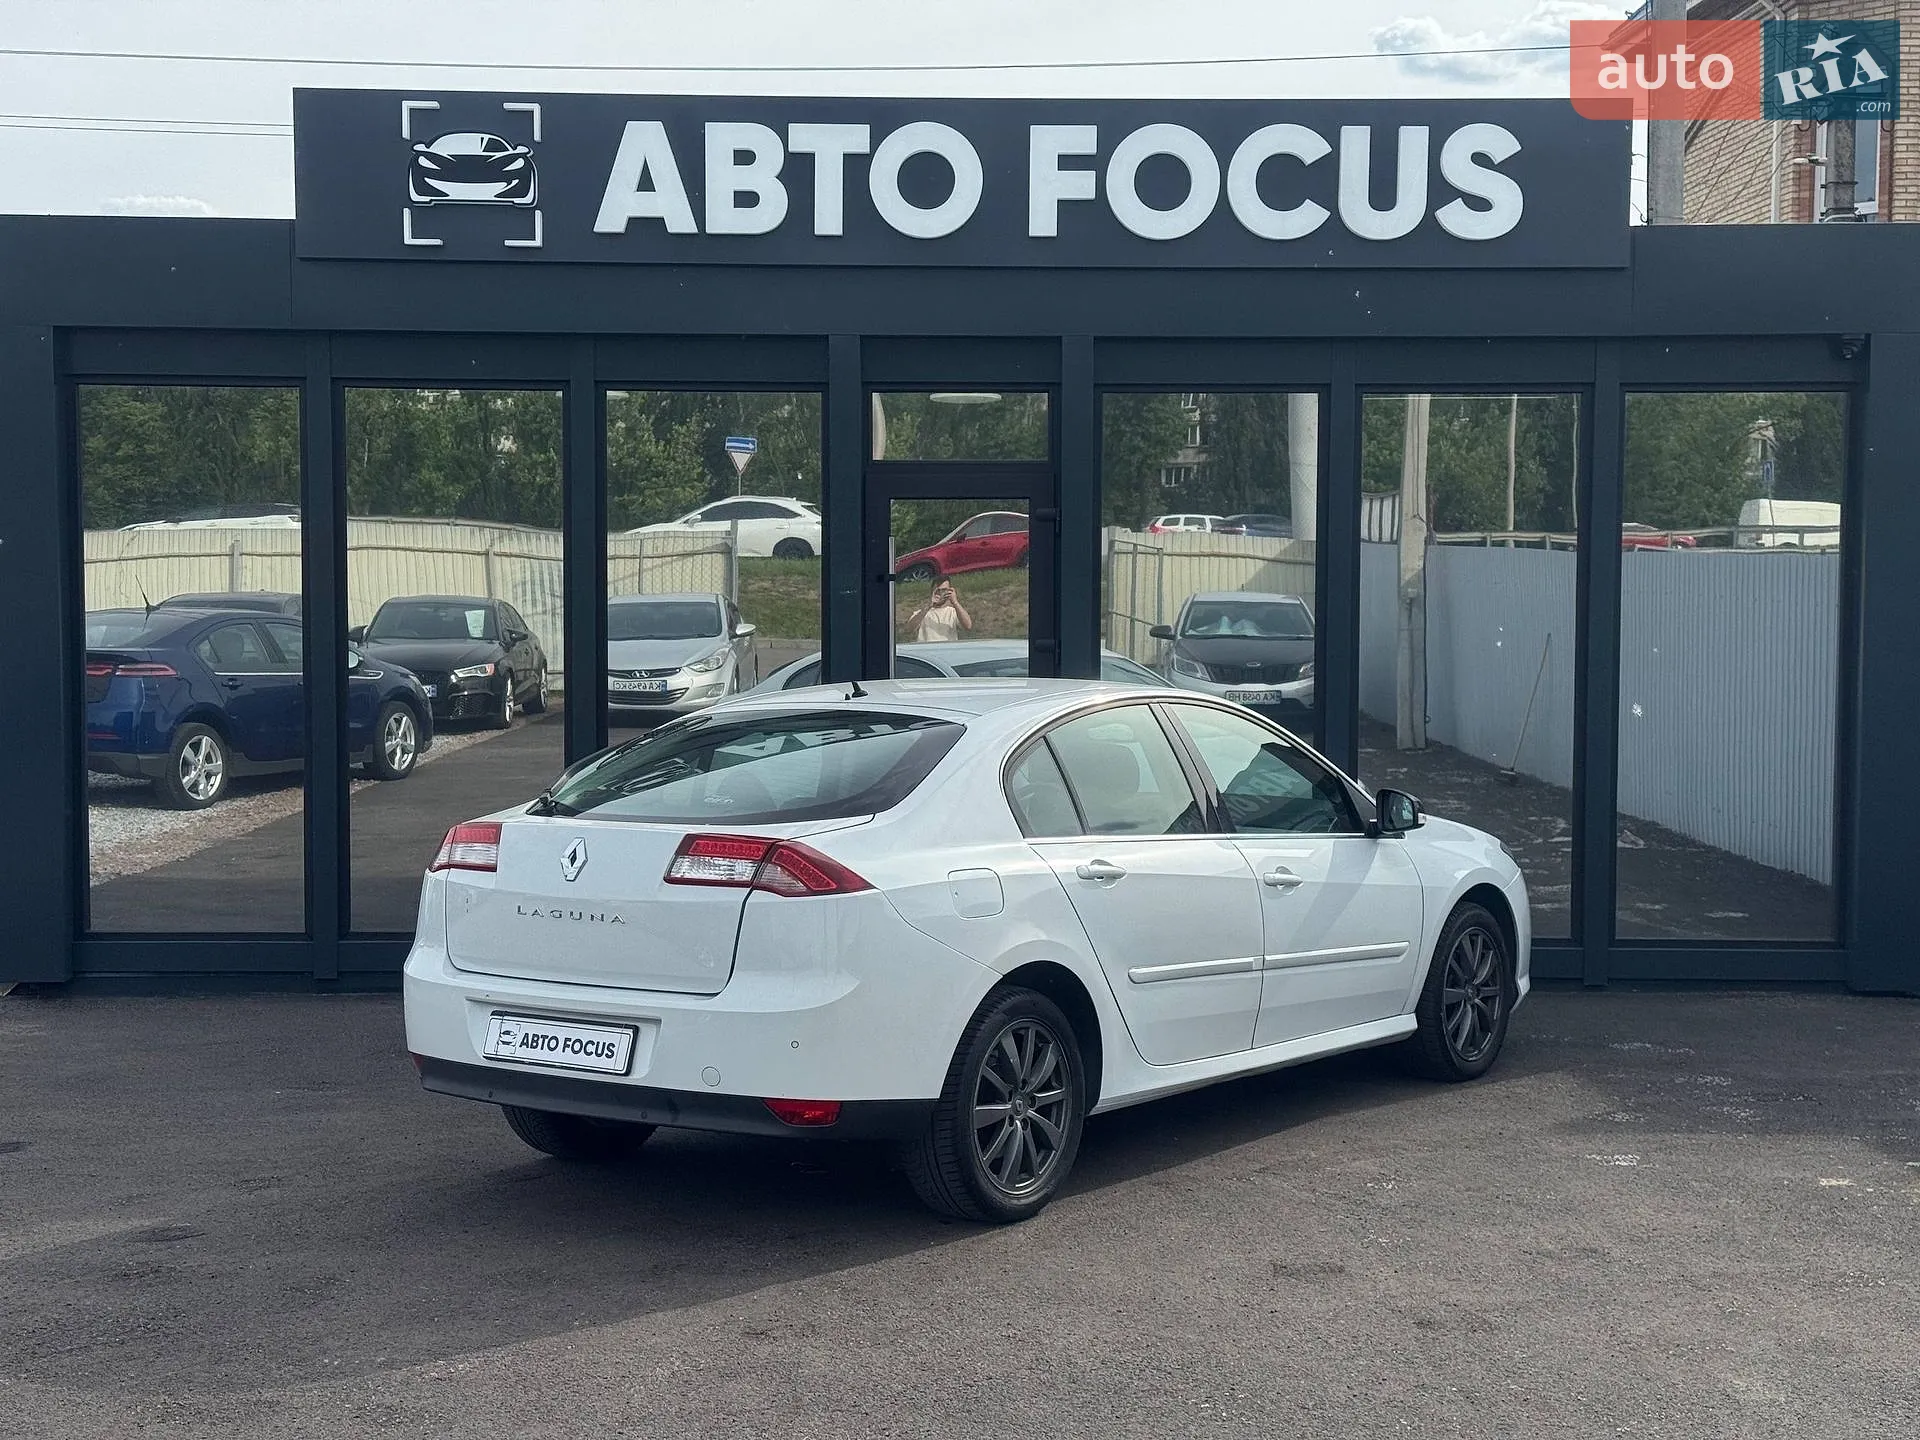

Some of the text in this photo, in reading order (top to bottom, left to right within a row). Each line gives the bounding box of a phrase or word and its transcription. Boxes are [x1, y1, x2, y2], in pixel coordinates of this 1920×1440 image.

[592, 120, 1523, 241] АВТО FOCUS
[517, 905, 625, 924] LAGUNA
[519, 1032, 616, 1059] АВТО FOCUS
